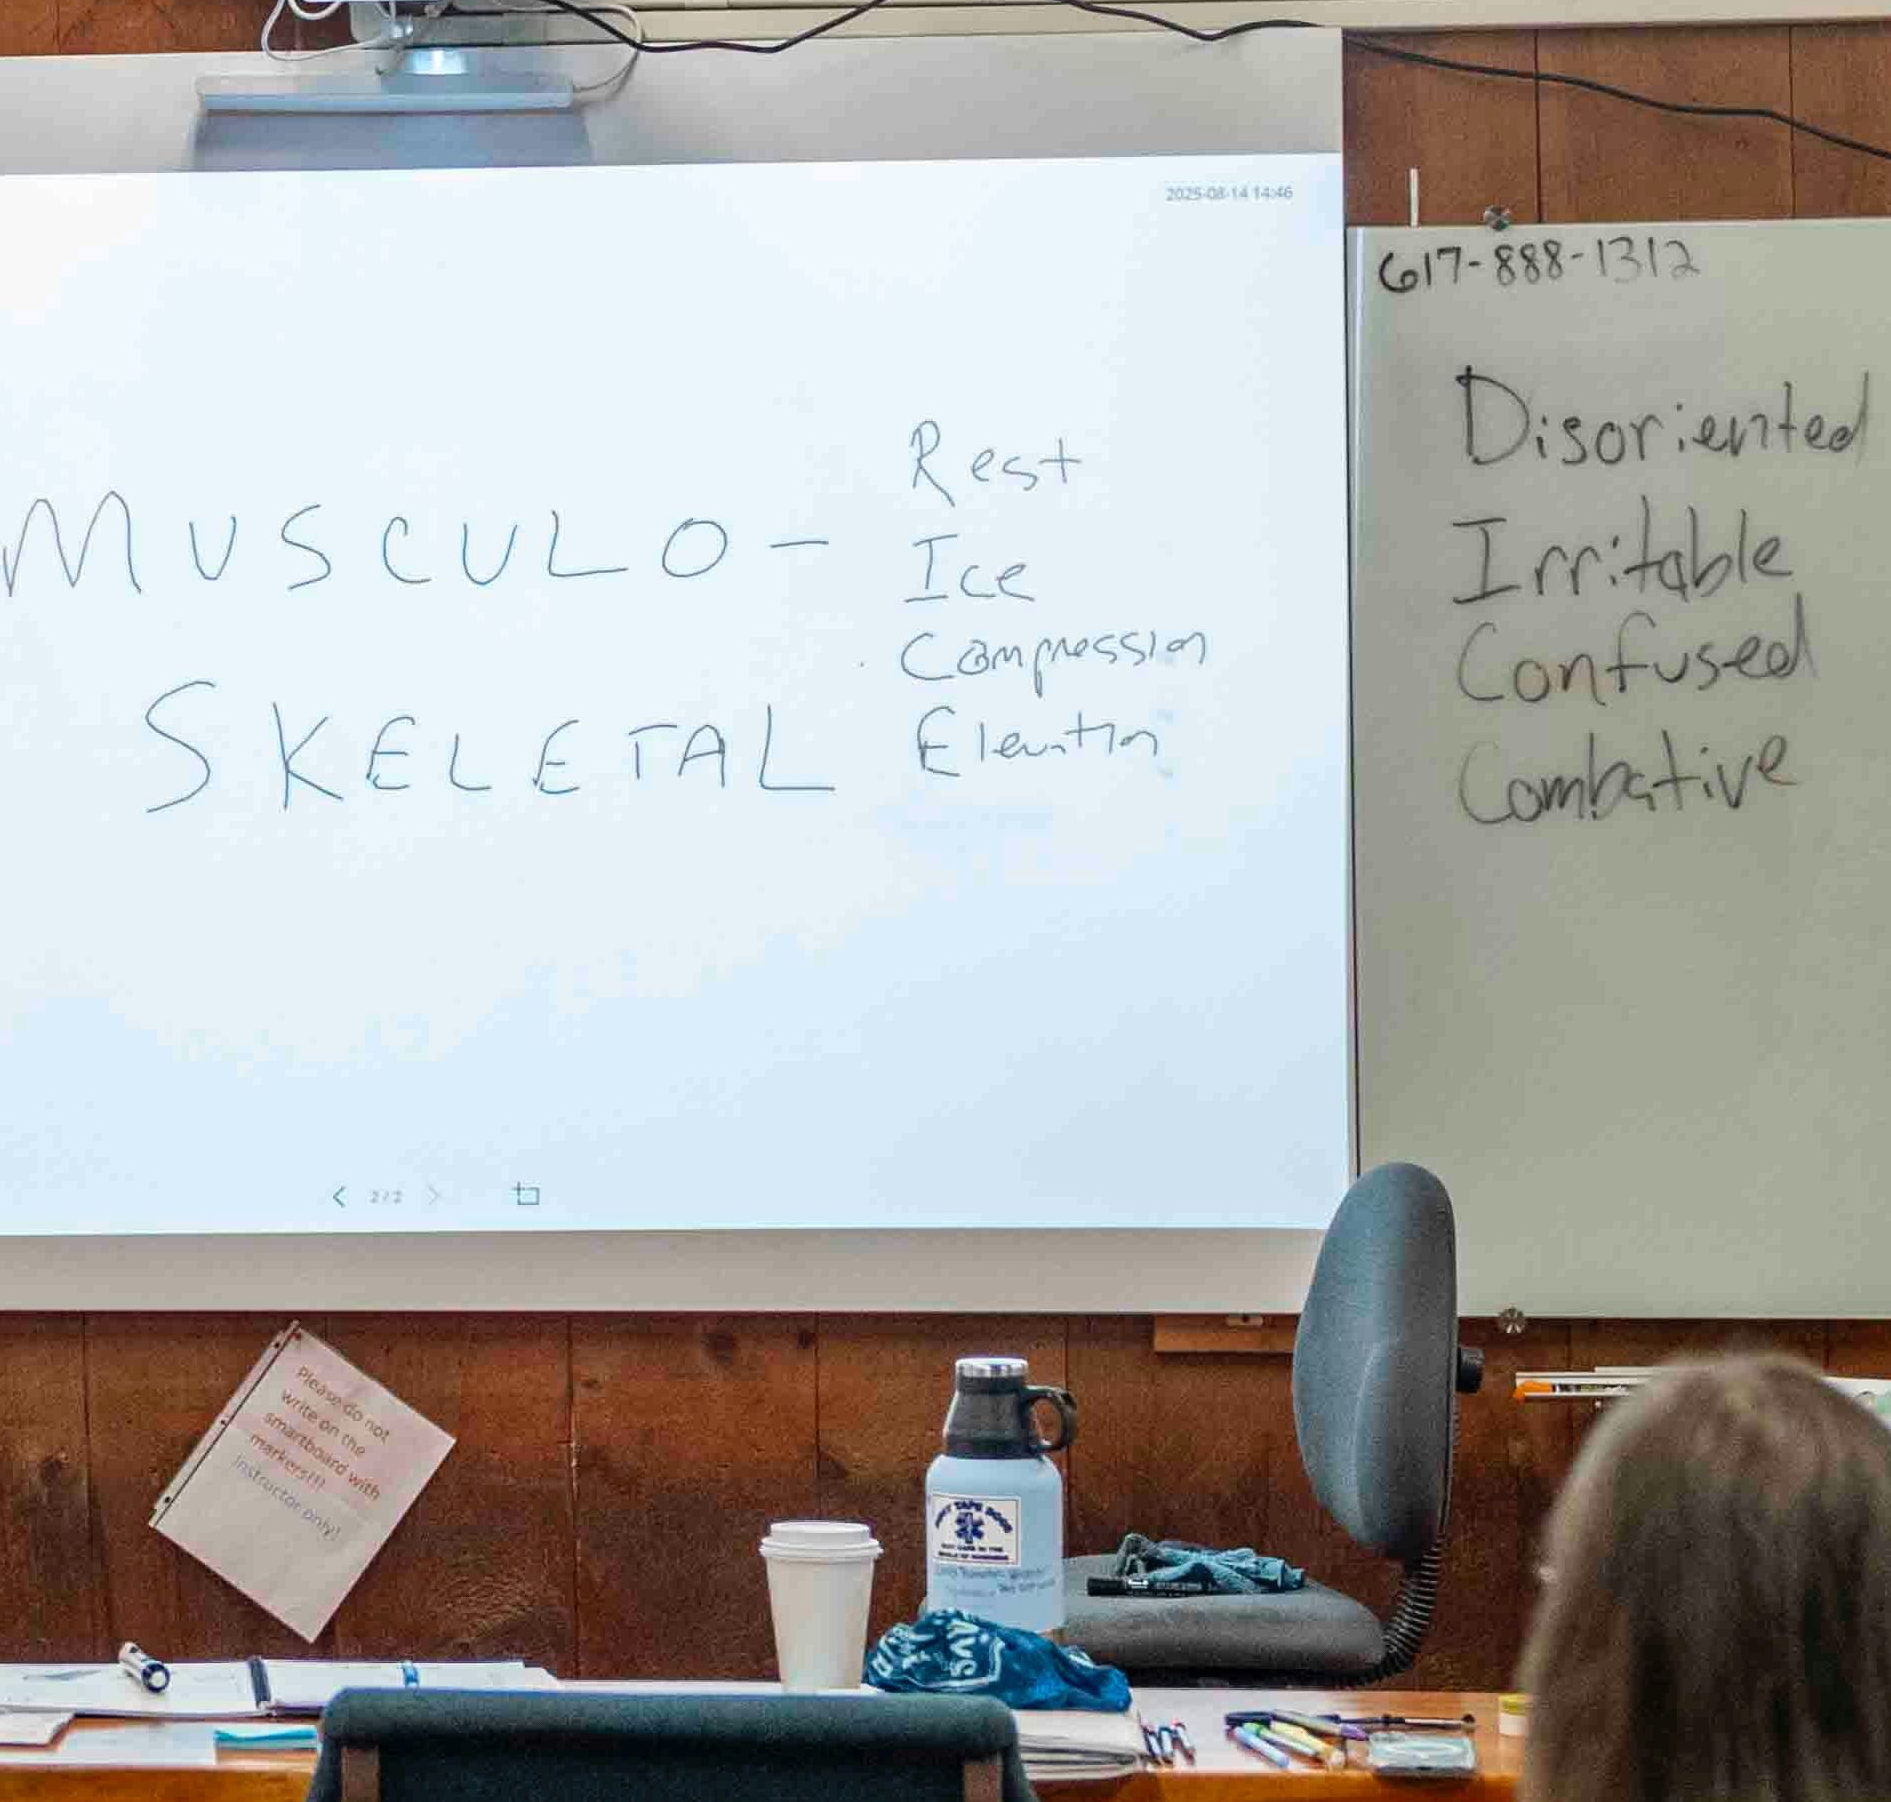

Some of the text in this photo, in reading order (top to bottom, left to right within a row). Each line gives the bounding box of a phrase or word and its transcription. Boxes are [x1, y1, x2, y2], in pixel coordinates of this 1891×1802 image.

[1378, 236, 1702, 294] 617-888-1312
[1455, 364, 1870, 466] Disoriented
[910, 419, 1082, 508] Rest
[904, 533, 1036, 603] Ice
[1452, 495, 1793, 605] Irritable
[1457, 591, 1818, 707] Confused
[145, 680, 836, 813] SKELETAL
[1459, 729, 1799, 825] Combative
[263, 1412, 381, 1501] smartboard with
[281, 1388, 366, 1456] write on the
[342, 1402, 364, 1422] do
